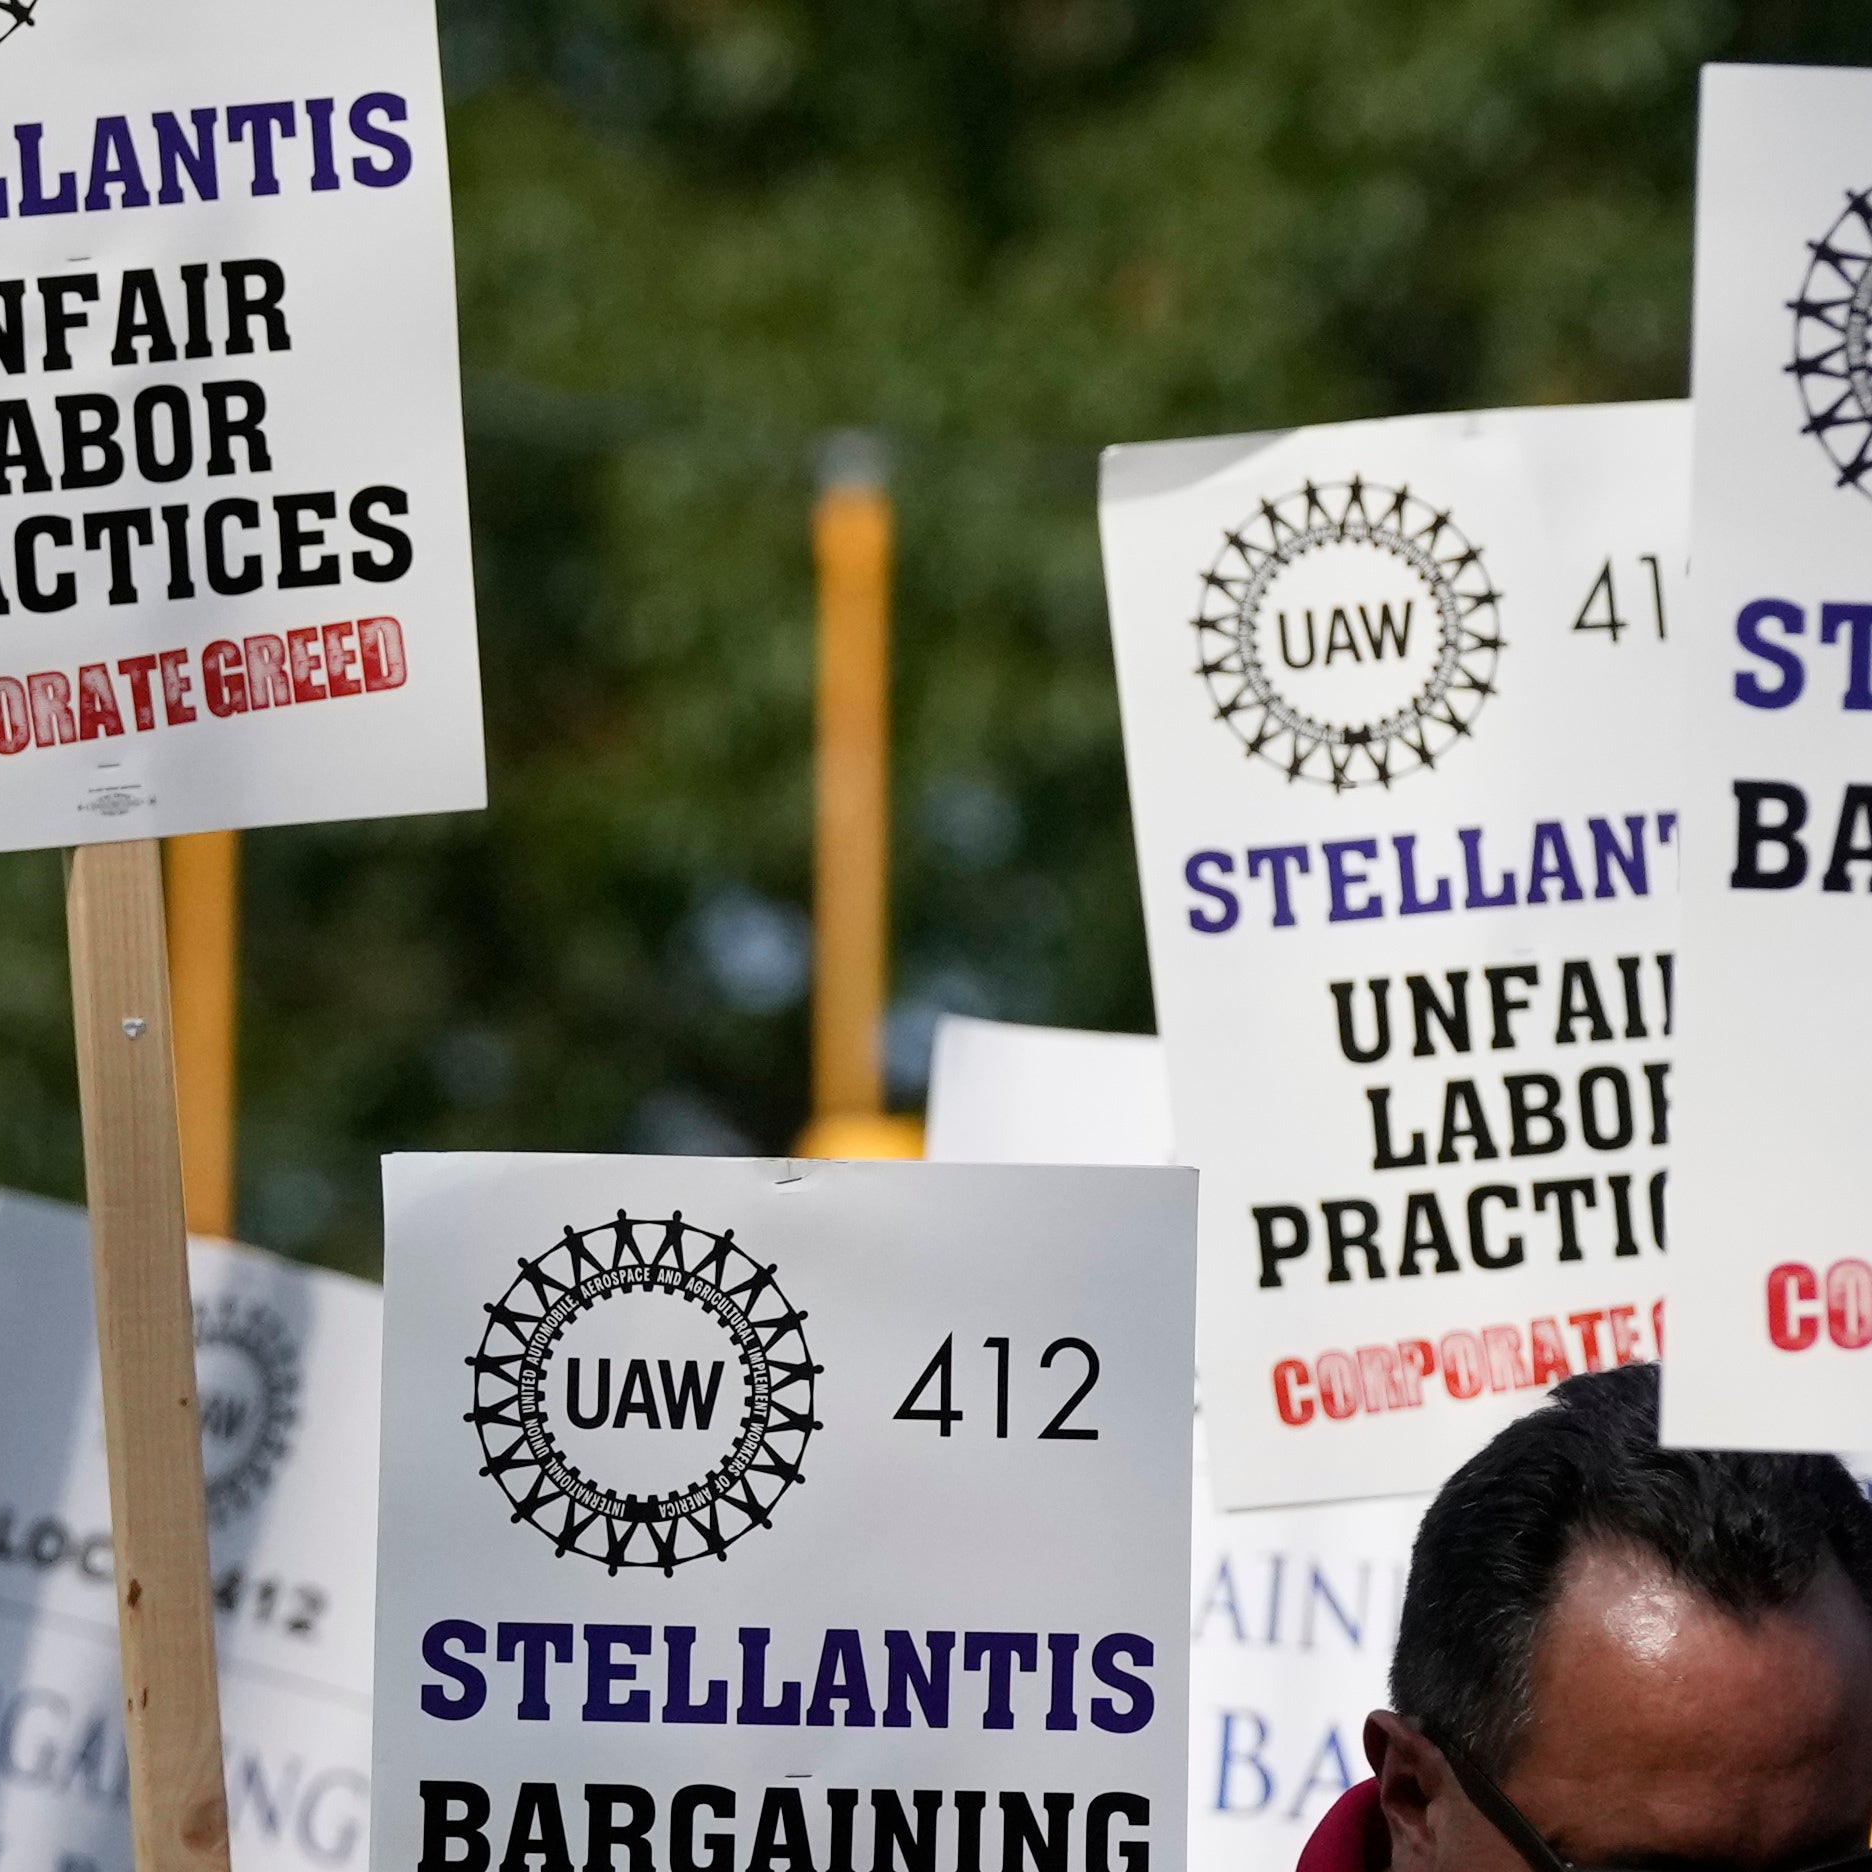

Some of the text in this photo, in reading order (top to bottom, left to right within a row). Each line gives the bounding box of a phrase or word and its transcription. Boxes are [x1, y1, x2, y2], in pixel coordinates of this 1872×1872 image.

[1571, 553, 1669, 643] 41
[202, 616, 409, 719] GREED
[1278, 600, 1413, 669] UAW
[1184, 812, 1677, 934] STELLAN
[1330, 950, 1673, 1064] UNFAI
[1252, 1169, 1668, 1288] PRACTI
[579, 1267, 651, 1300] AEROSPACE
[656, 1267, 683, 1287] AND
[684, 1276, 756, 1346] AGRICULTURAL
[521, 1368, 537, 1414] UNITED
[566, 1357, 726, 1431] UAW
[746, 1346, 769, 1418] IMPLEMENT
[892, 1331, 1100, 1441] 412
[1272, 1306, 1640, 1427] CORPORATE
[524, 1418, 550, 1459] UNION
[728, 1421, 765, 1478] WORKERS
[544, 1456, 626, 1518] INTERNATIONAL
[659, 1485, 713, 1519] AMERICA
[713, 1474, 731, 1494] OF
[420, 1619, 1157, 1733] STELLANTIS
[1214, 1708, 1354, 1823] BA
